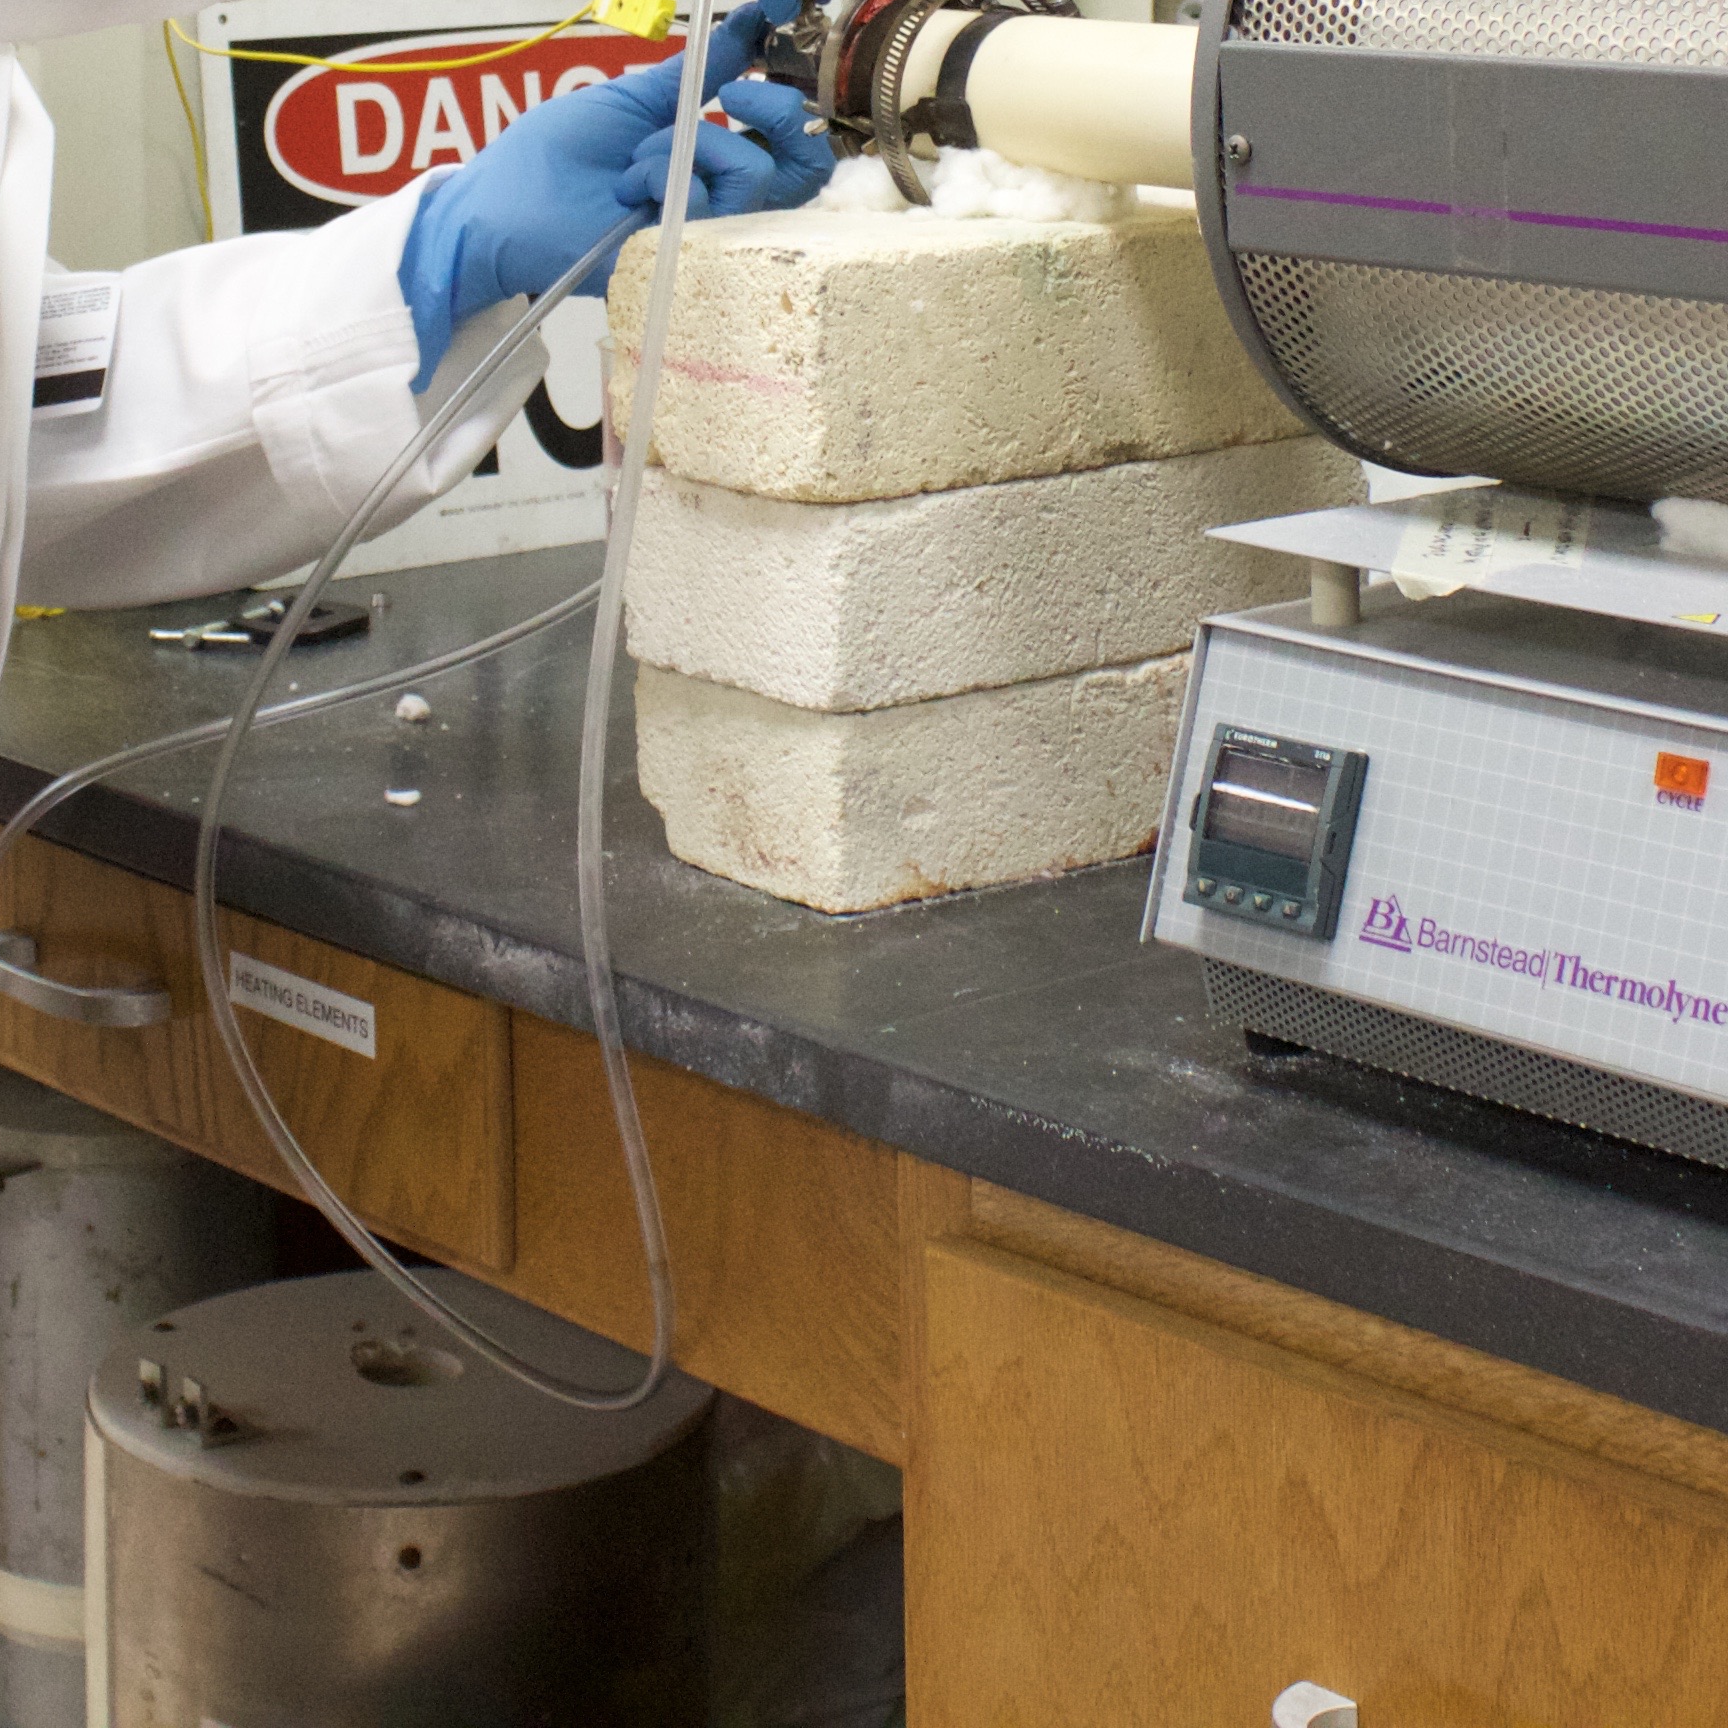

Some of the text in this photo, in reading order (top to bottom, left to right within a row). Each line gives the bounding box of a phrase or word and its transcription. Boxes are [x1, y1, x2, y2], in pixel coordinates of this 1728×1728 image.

[1657, 790, 1704, 813] CYCLE
[1417, 917, 1547, 979] Barnstead
[235, 970, 370, 1039] HEATING ELEMENTS
